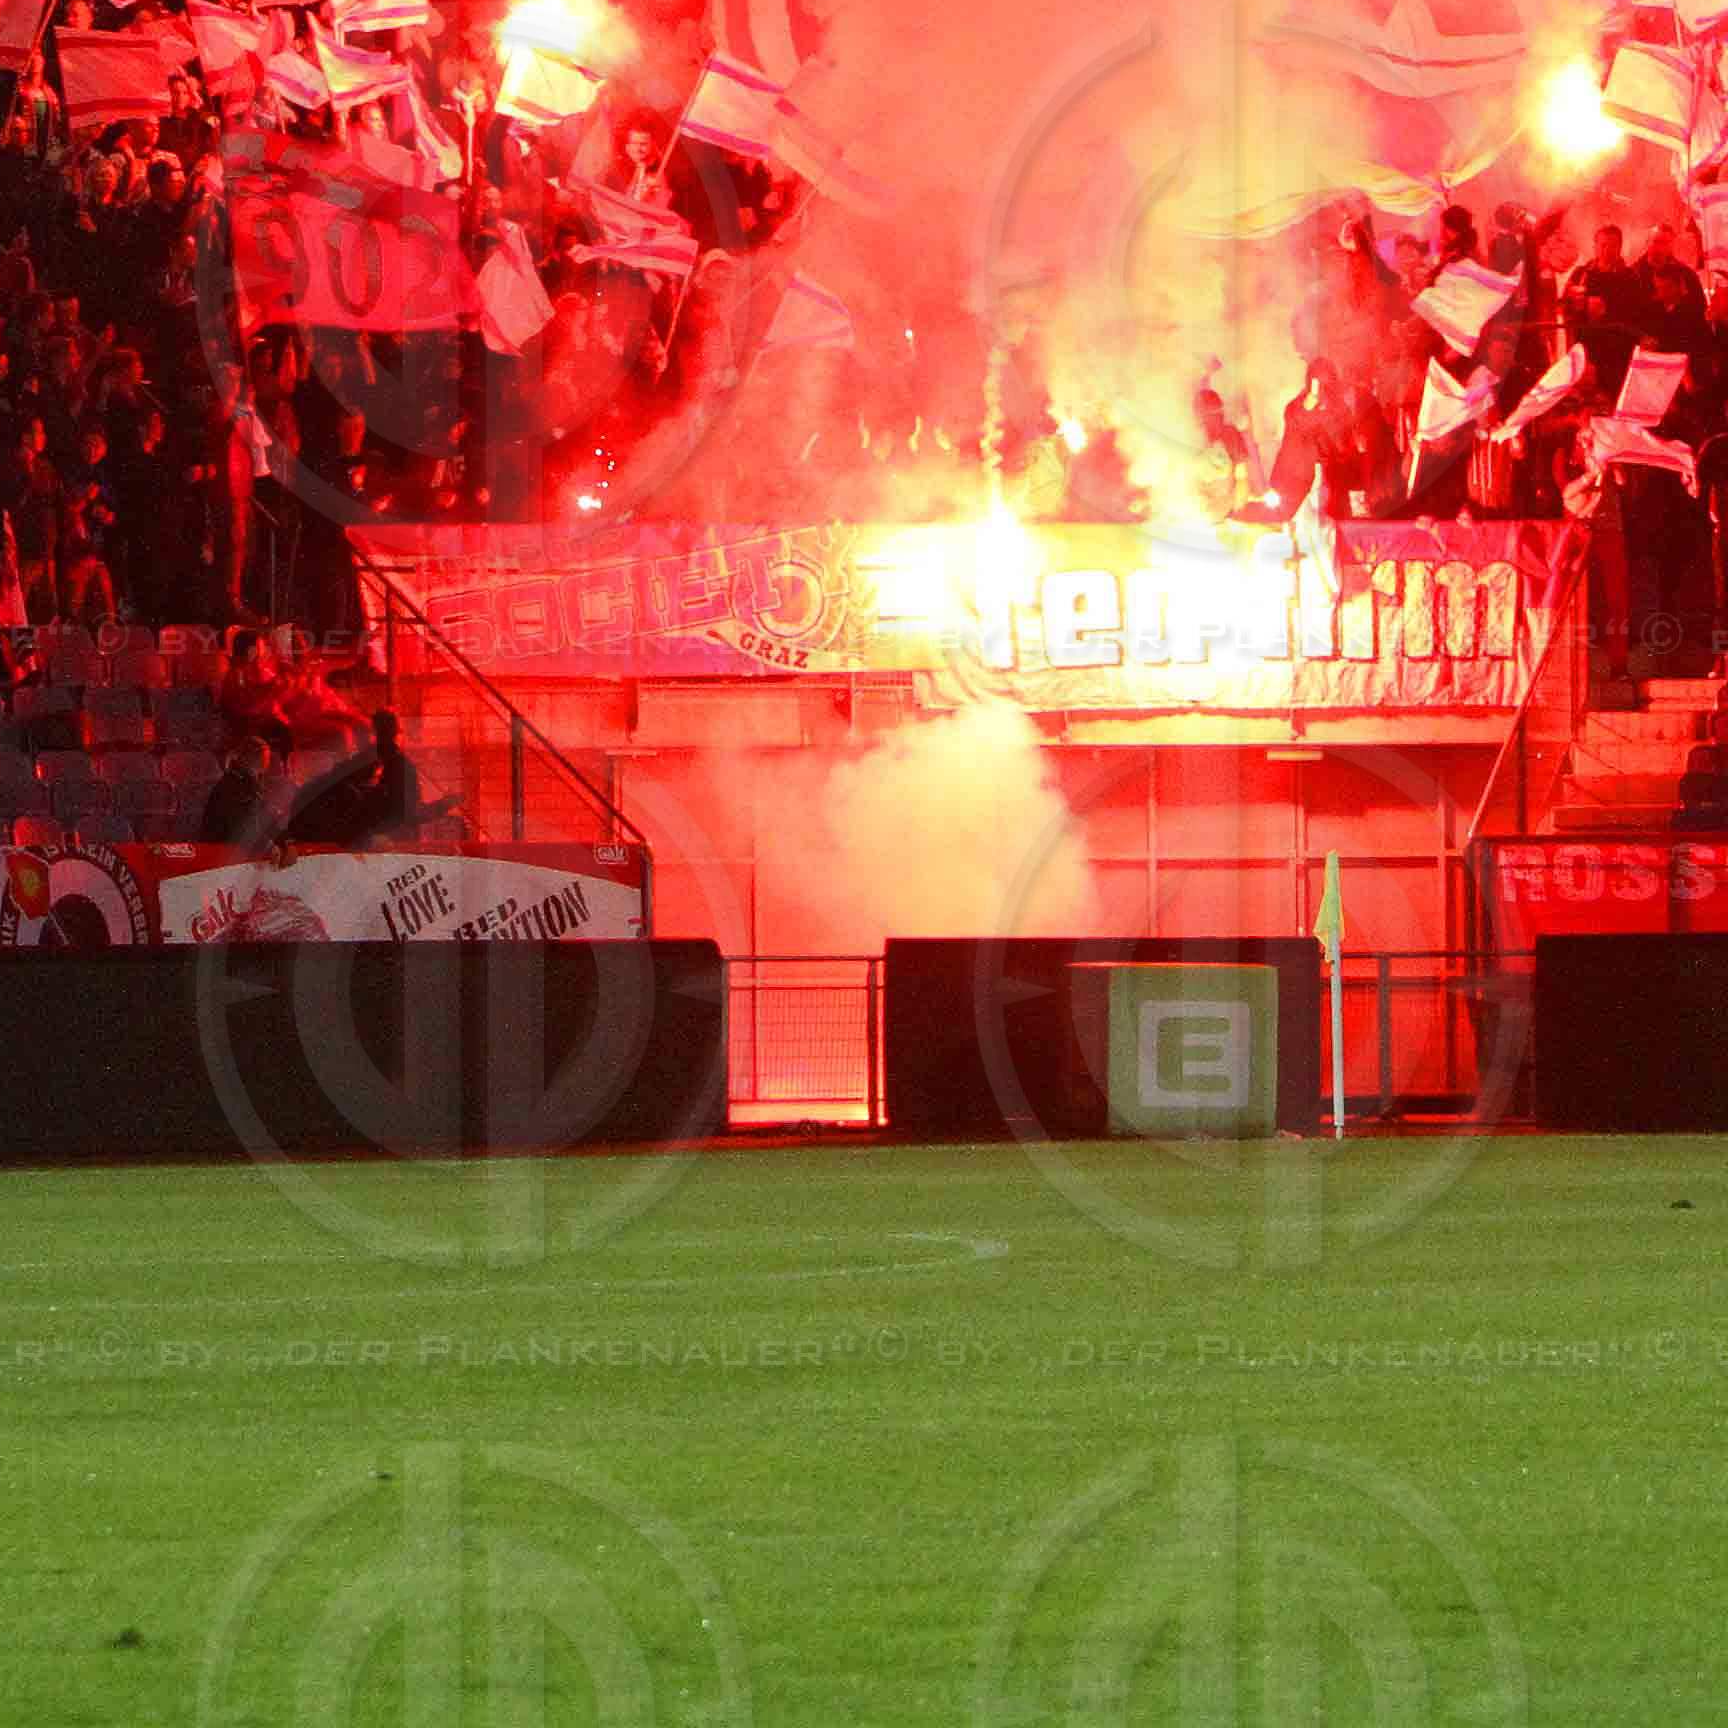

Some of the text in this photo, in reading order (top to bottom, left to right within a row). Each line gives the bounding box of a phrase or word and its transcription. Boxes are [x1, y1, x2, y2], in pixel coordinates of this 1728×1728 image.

[737, 630, 810, 670] GRAZ
[386, 863, 428, 898] RED
[381, 873, 456, 944] LOVE
